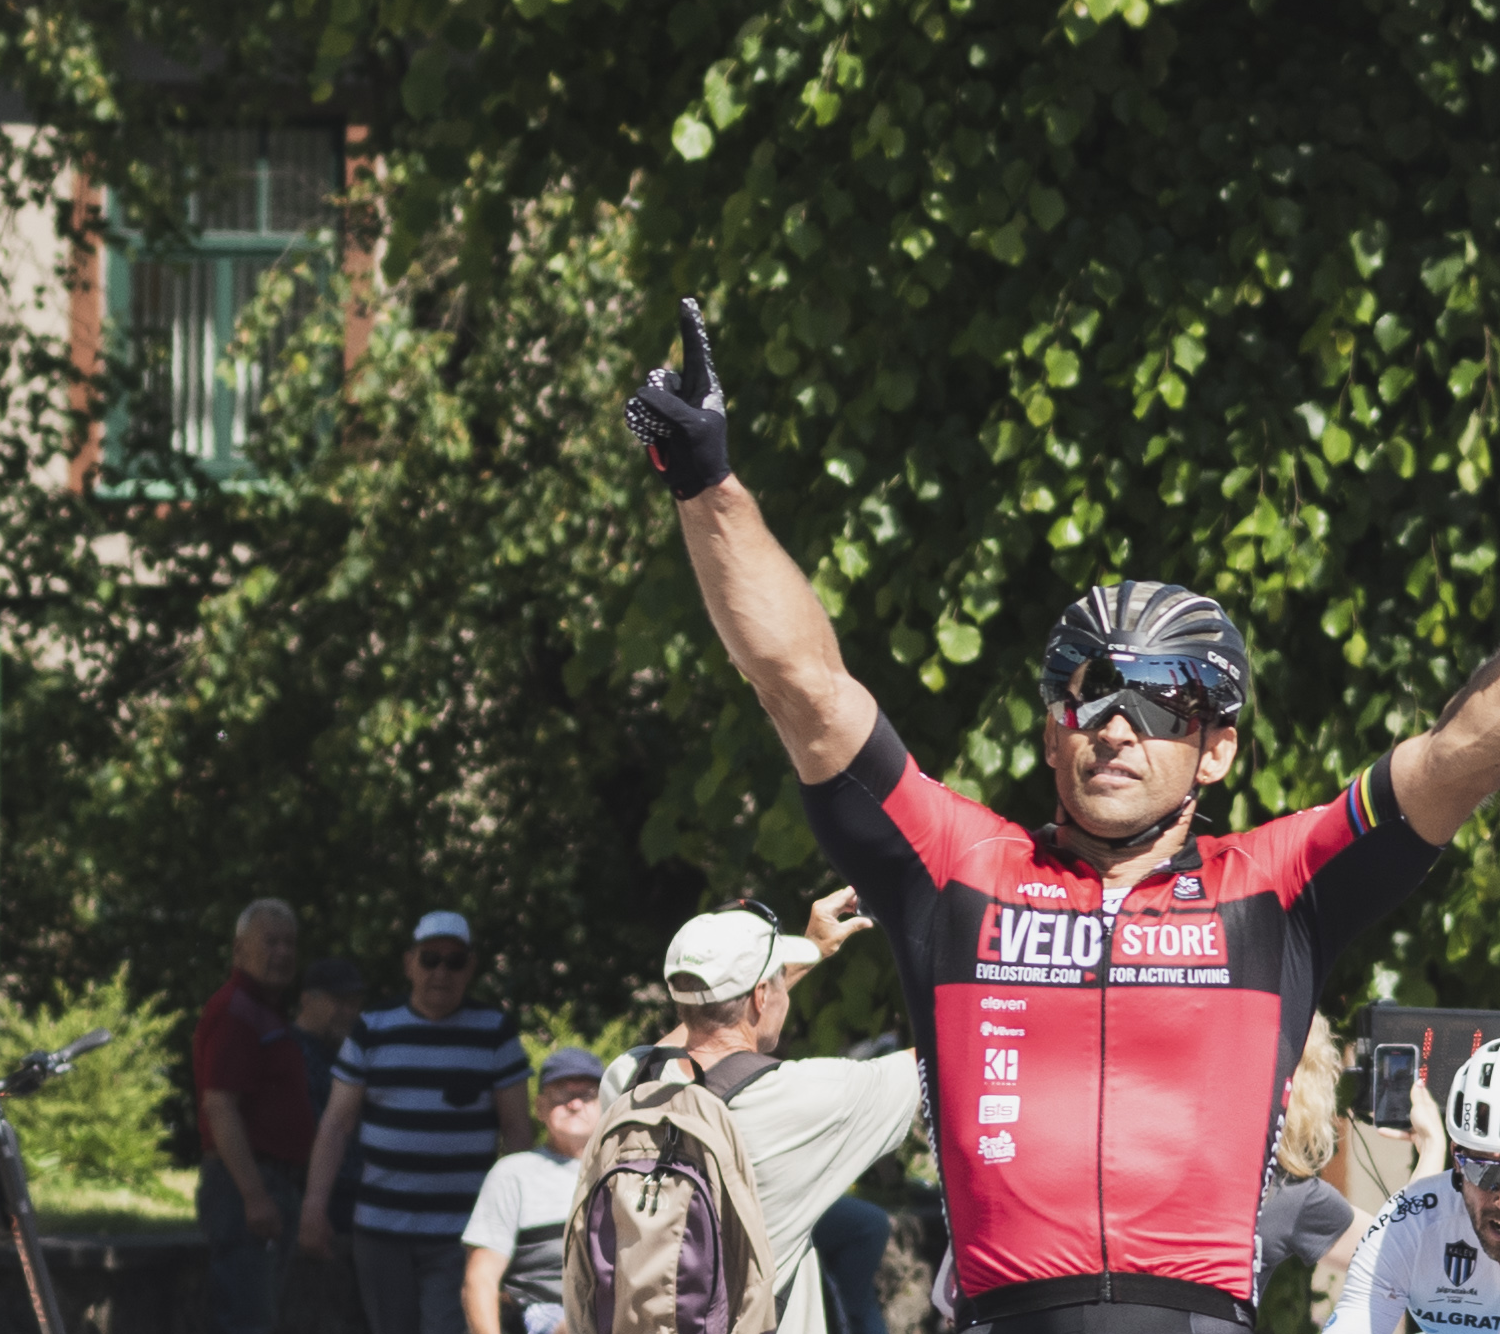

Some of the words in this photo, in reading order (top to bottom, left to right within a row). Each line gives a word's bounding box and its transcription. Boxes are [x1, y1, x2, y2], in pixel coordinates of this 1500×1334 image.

[1016, 881, 1067, 899] LATVIA
[976, 903, 1103, 968] EVELO
[1120, 920, 1219, 957] STORE
[975, 964, 1082, 984] EVELOSTORE.COM
[1108, 967, 1136, 984] FOR
[1137, 967, 1186, 985] ACTIVE
[1186, 968, 1230, 985] LIVING
[980, 996, 1027, 1011] eleven
